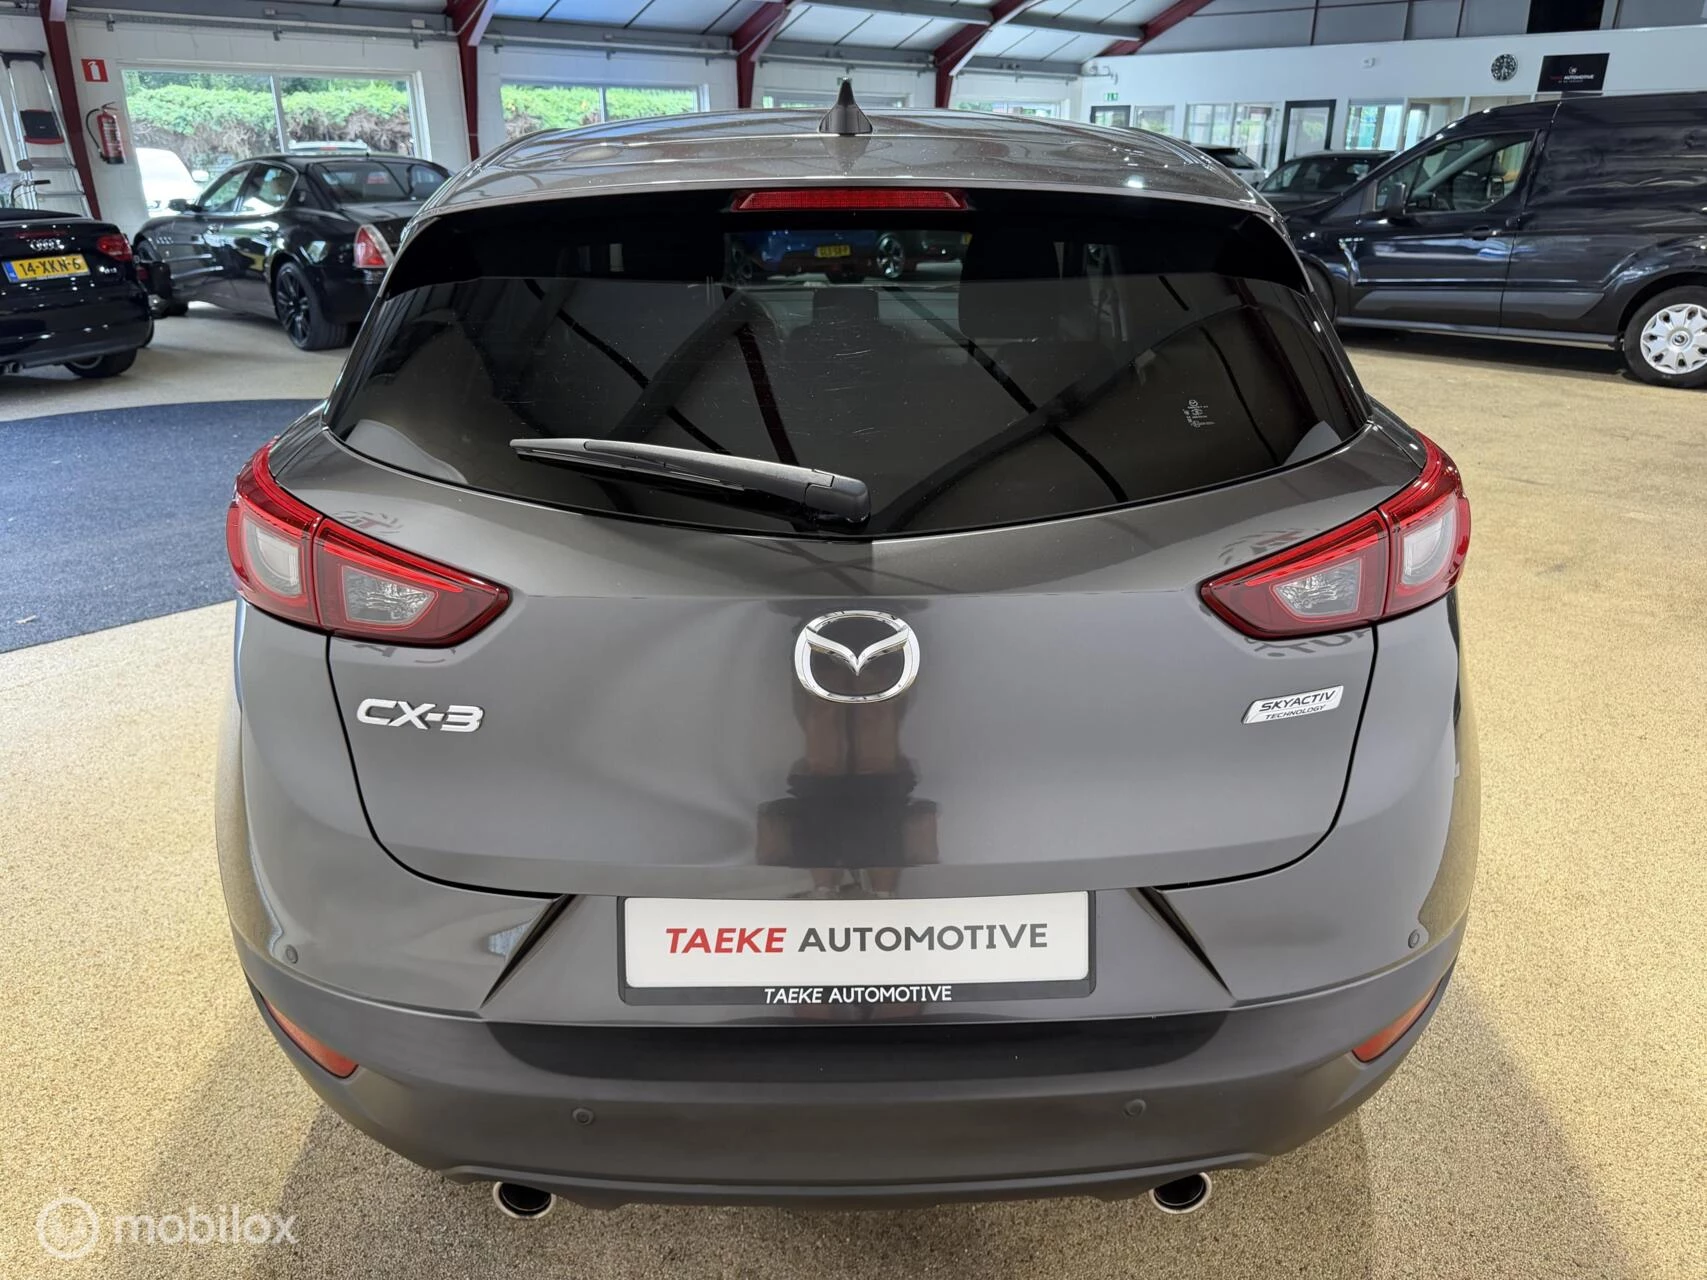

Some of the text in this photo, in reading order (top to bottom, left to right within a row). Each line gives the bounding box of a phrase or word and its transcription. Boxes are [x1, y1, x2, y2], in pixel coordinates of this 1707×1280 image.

[19, 258, 82, 276] 14-XKN-6
[1258, 690, 1336, 712] SKYACTIV
[356, 698, 484, 732] CX-3
[1265, 704, 1326, 720] TECHNOLOGY
[665, 923, 1048, 954] TAEKE AUTOMOTIVE
[764, 985, 952, 1004] TAEKE AUTOMOTIVE
